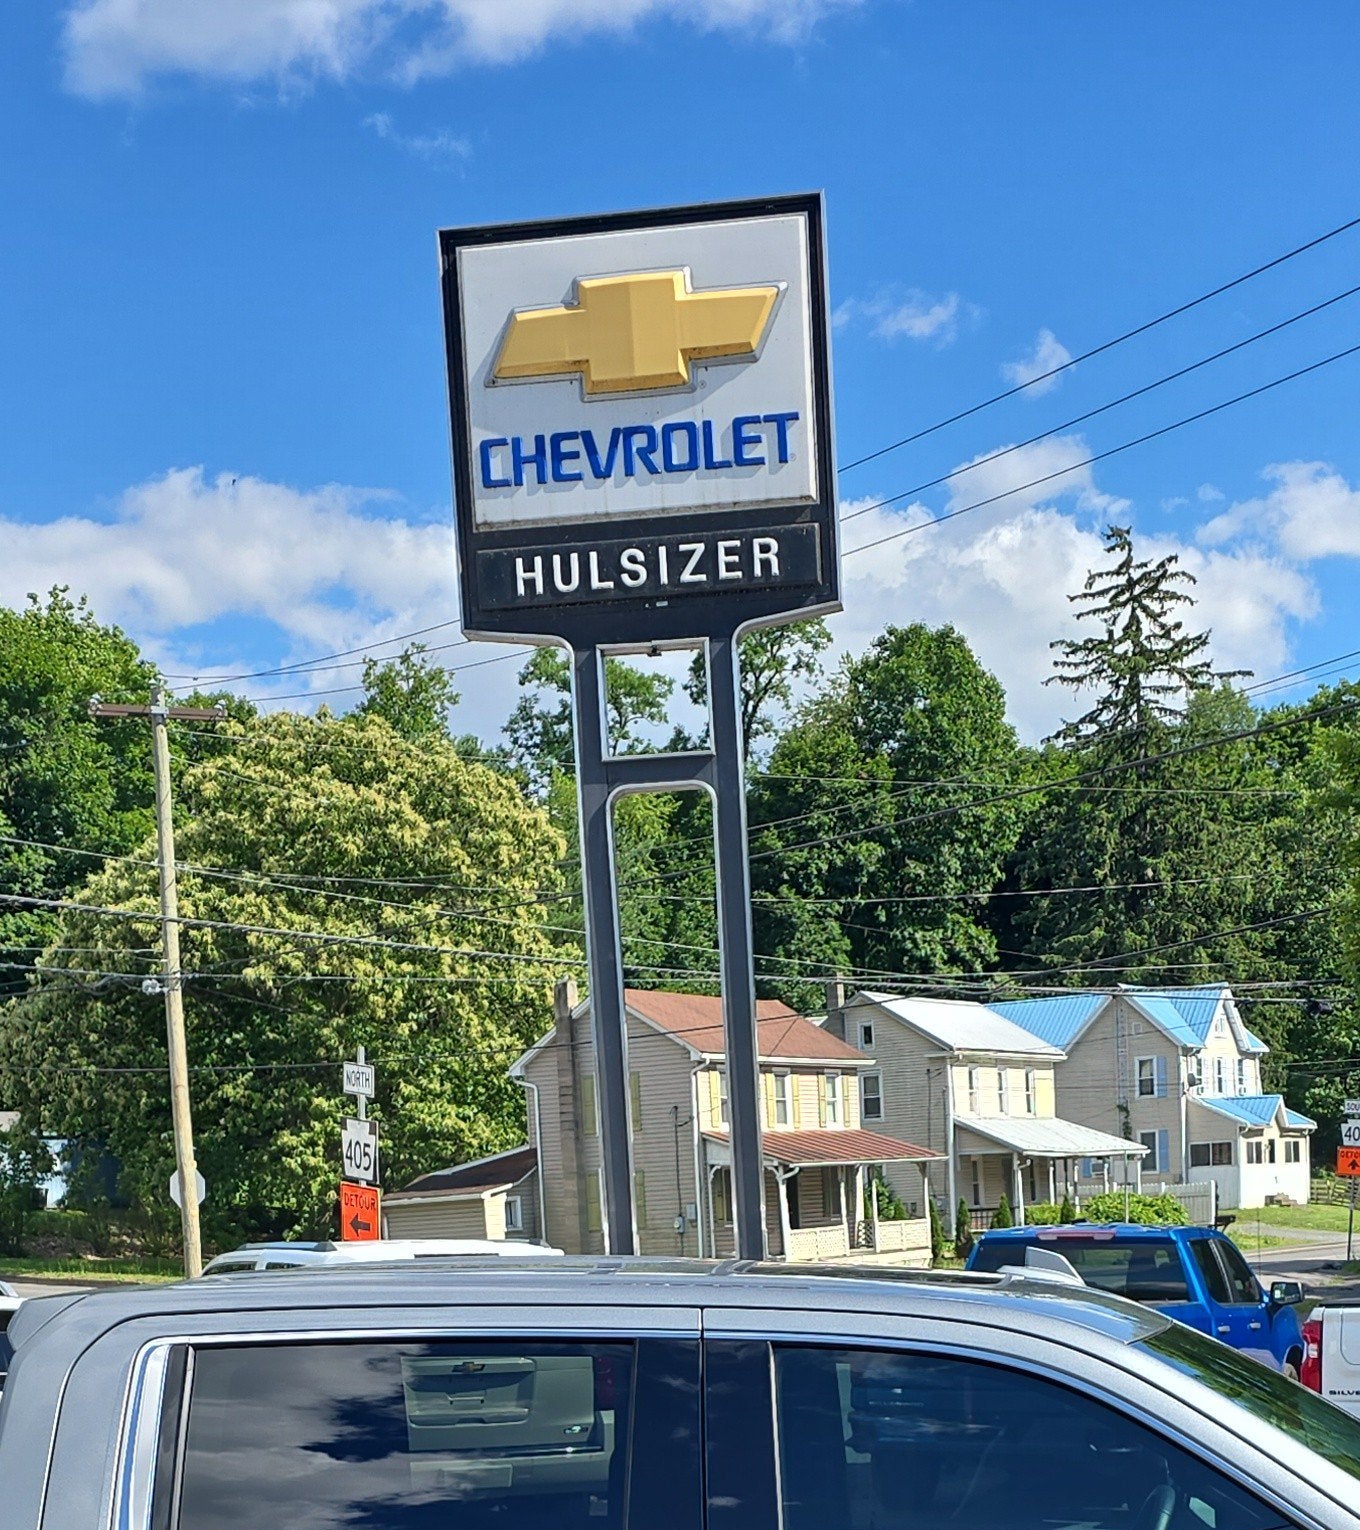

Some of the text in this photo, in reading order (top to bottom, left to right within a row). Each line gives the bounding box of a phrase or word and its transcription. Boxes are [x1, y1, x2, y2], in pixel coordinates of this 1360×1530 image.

[479, 411, 800, 489] CHEVROLET
[514, 536, 781, 597] HULSIZER
[346, 1069, 370, 1089] NORTH
[345, 1138, 372, 1172] 405
[344, 1191, 377, 1211] DETOUR
